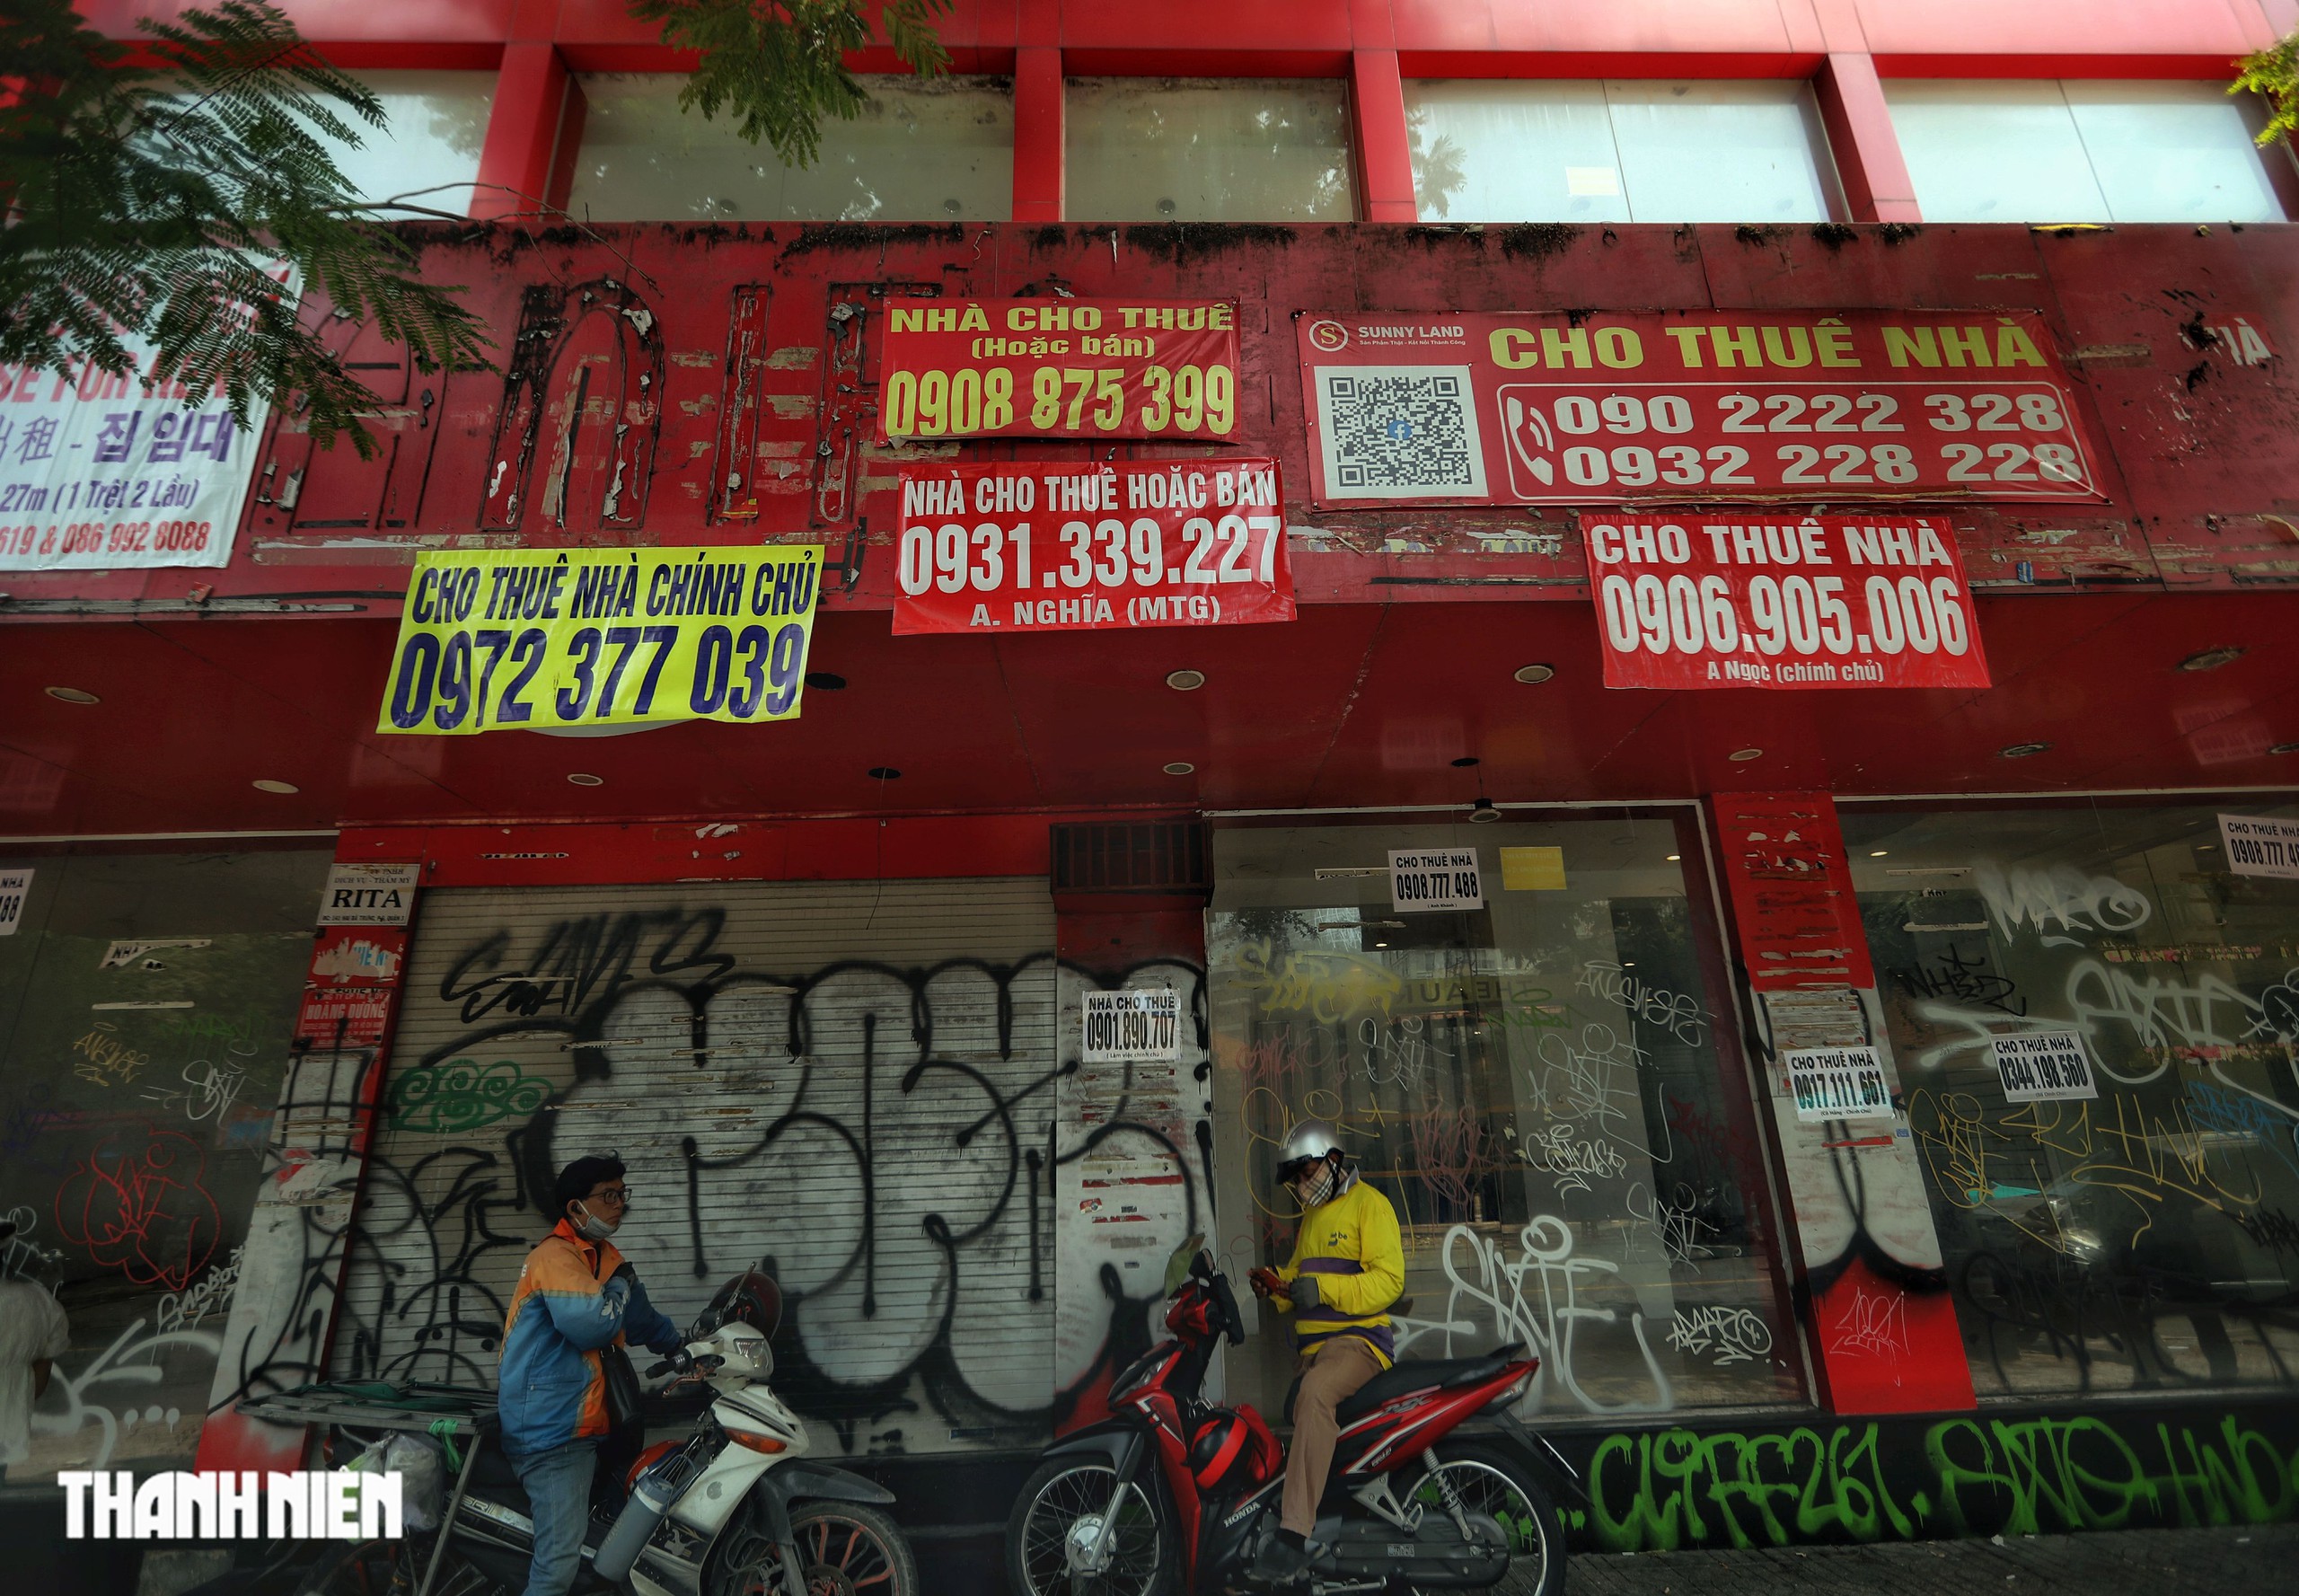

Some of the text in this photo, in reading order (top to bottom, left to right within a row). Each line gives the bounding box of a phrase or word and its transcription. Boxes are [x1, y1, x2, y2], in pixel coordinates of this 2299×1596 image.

[890, 303, 1234, 333] NHÀ CHO THUÊ
[1358, 325, 1464, 339] SUNNY LAND
[972, 334, 1156, 359] (Hoặc bán)
[1489, 317, 2048, 369] CHO THUÊ NHÀ
[885, 365, 1234, 437] 0908 875 399
[1554, 393, 2064, 435] 090 2222 328
[92, 410, 234, 463] 집 임대
[1563, 443, 2083, 486] 0932 228 228
[85, 479, 129, 515] Trệt
[130, 479, 149, 508] 2
[149, 473, 199, 509] Lầu)
[904, 463, 1278, 518] NHÀ CHO THUÊ HOẶC BÁN
[40, 525, 57, 555] &
[62, 523, 105, 554] 086
[108, 521, 151, 553] 992
[154, 520, 212, 552] 8088
[902, 515, 1282, 596] 0931.339.227
[1590, 518, 1952, 567] CHO THUÊ NHÀ
[411, 550, 817, 624] CHO THUÊ NHÀ CHÍNH CHỦ
[970, 593, 1220, 627] A. NGHĨA (MTG)
[1601, 573, 1969, 657] 0906.905.006
[390, 622, 806, 729] 0972 377 039
[1707, 658, 1884, 684] A Ngọc (chính chủ)
[2227, 822, 2250, 833] CHO
[2251, 823, 2279, 835] THUÊ
[1396, 852, 1473, 868] CHO THUÊ NHÀ
[330, 889, 401, 908] RITA
[1396, 871, 1478, 900] 0908.777.488
[305, 1001, 346, 1019] HOÀNG
[1088, 992, 1176, 1010] NHÀ CHO THUÊ
[1088, 1010, 1176, 1051] 0901.890.707
[1995, 1034, 2075, 1054] CHO THUÊ NHÀ
[1791, 1049, 1875, 1070] CHO THUÊ NHÀ
[1999, 1053, 2089, 1091] 0344.198.560
[1793, 1070, 1887, 1109] 0917.111.661
[1223, 1501, 1262, 1529] HONDA
